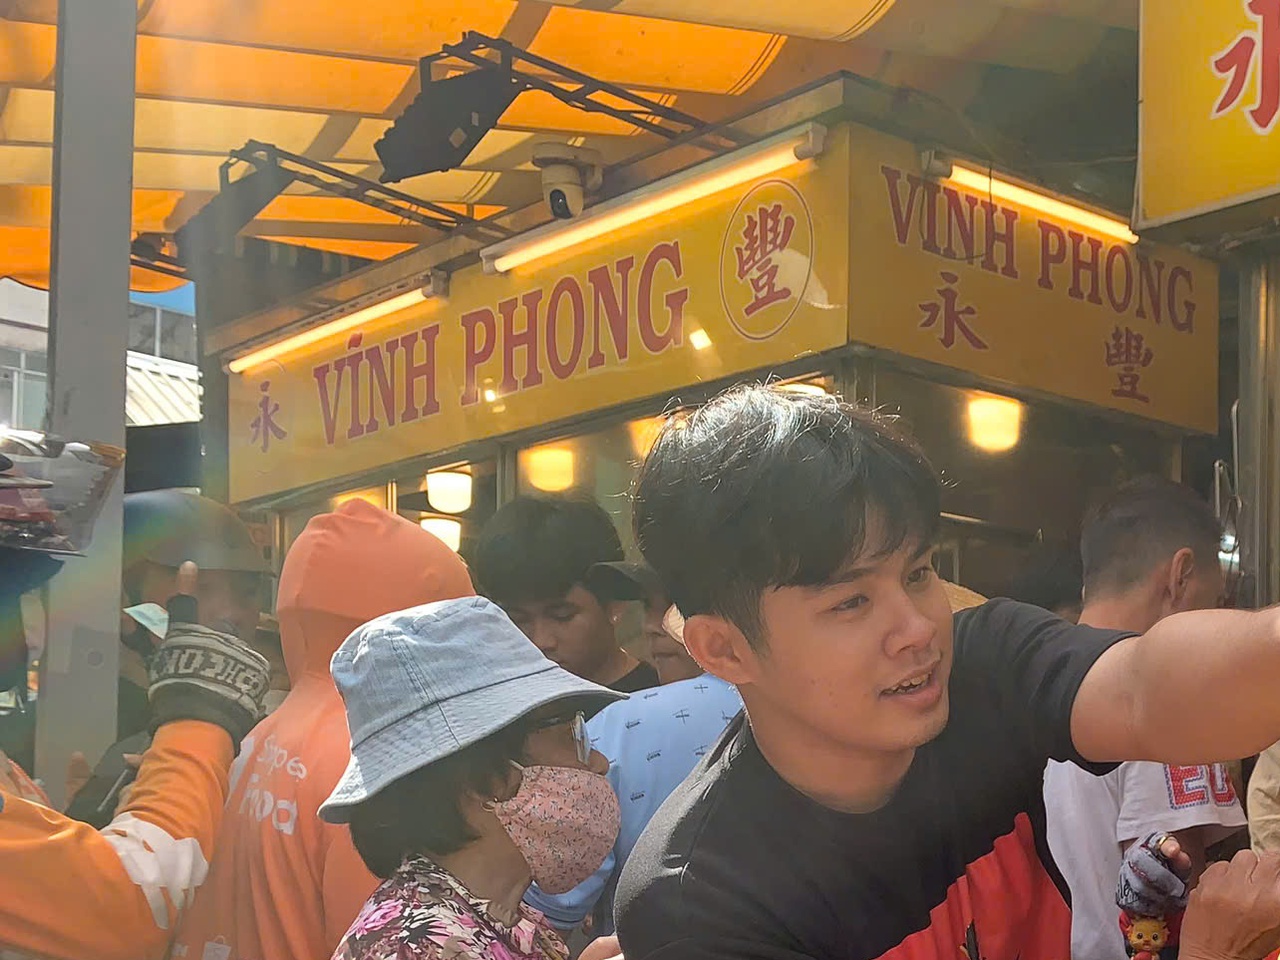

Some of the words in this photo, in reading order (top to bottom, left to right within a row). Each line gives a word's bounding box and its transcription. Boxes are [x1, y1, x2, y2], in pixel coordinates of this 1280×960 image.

[735, 204, 795, 318] 豐
[1037, 219, 1196, 334] PHONG
[461, 240, 688, 406] PHONG
[918, 271, 989, 350] 永
[1105, 327, 1153, 403] 豐
[251, 380, 287, 453] 永
